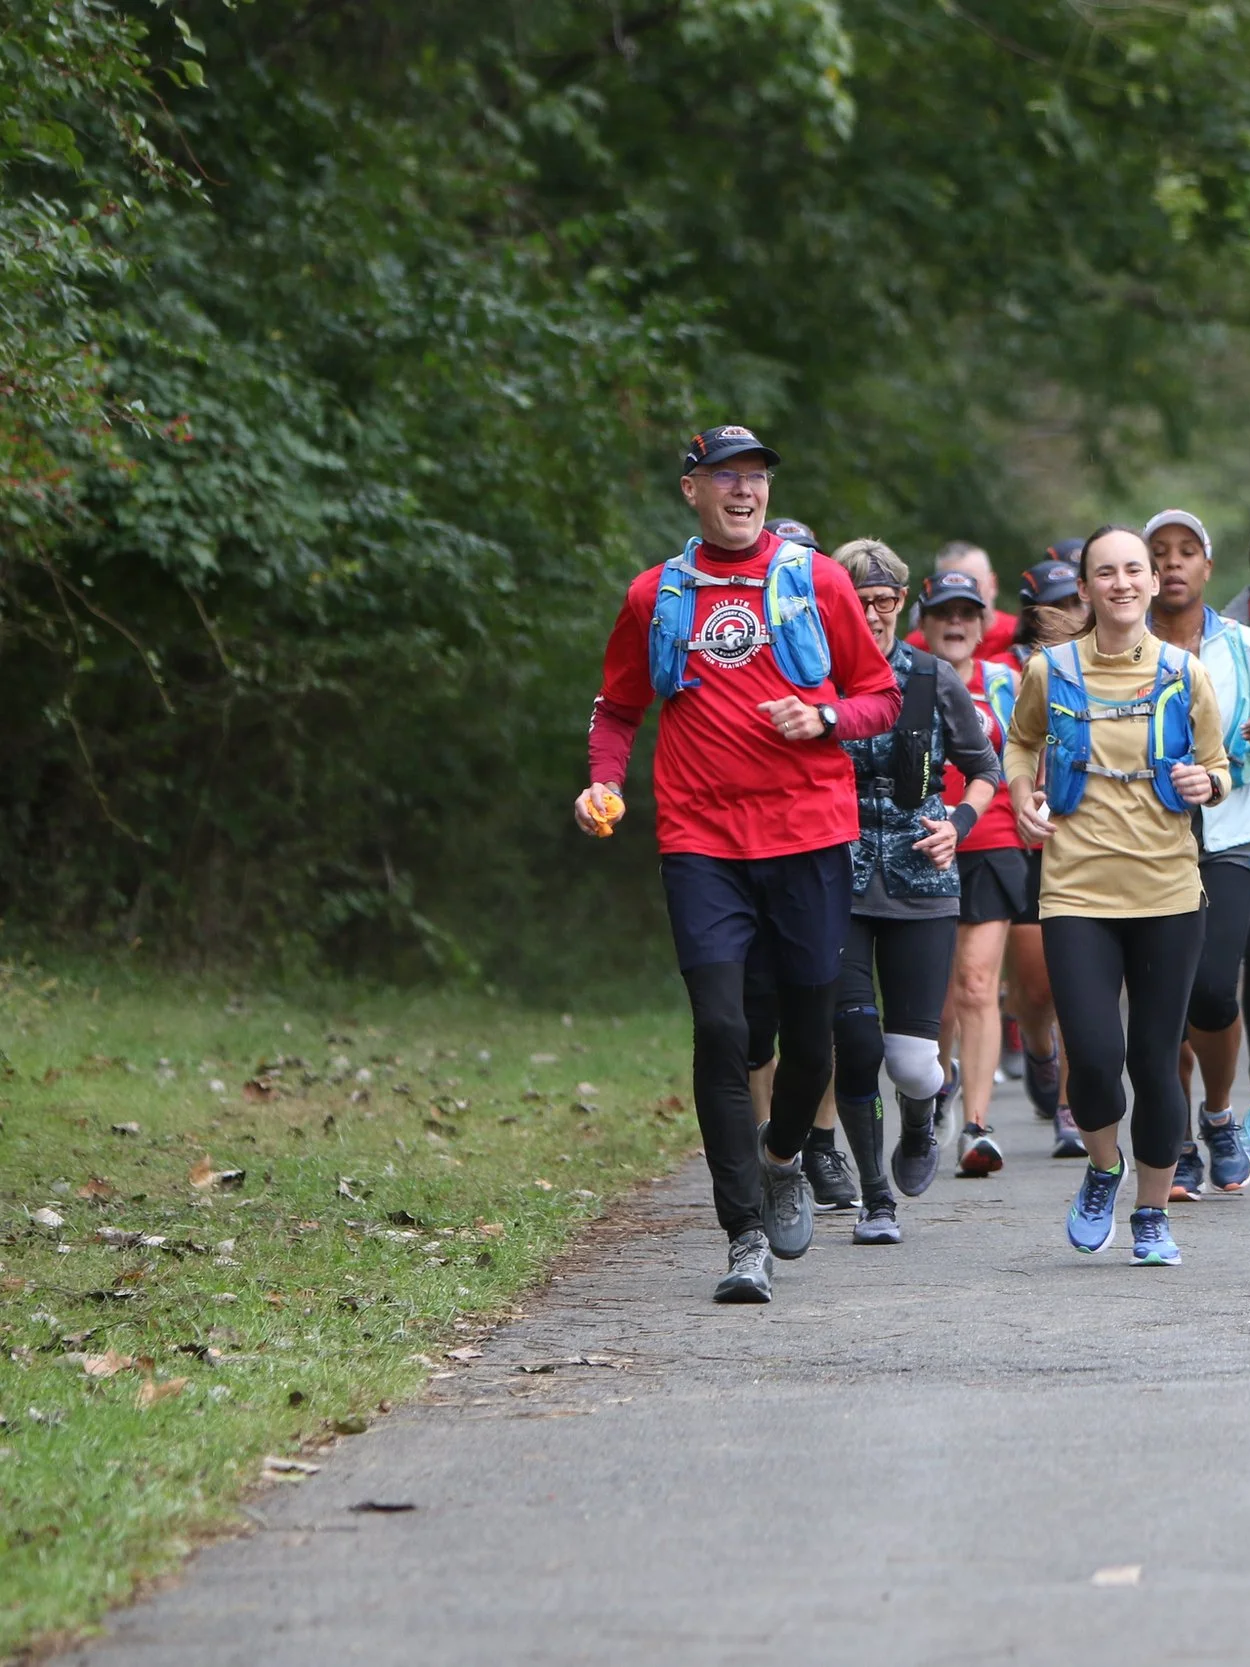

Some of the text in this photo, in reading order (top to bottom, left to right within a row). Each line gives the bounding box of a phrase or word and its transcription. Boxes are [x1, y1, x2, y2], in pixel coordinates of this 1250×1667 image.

[733, 599, 750, 608] FTM
[708, 611, 739, 632] MONTGOMERY
[718, 658, 752, 670] TRAINING
